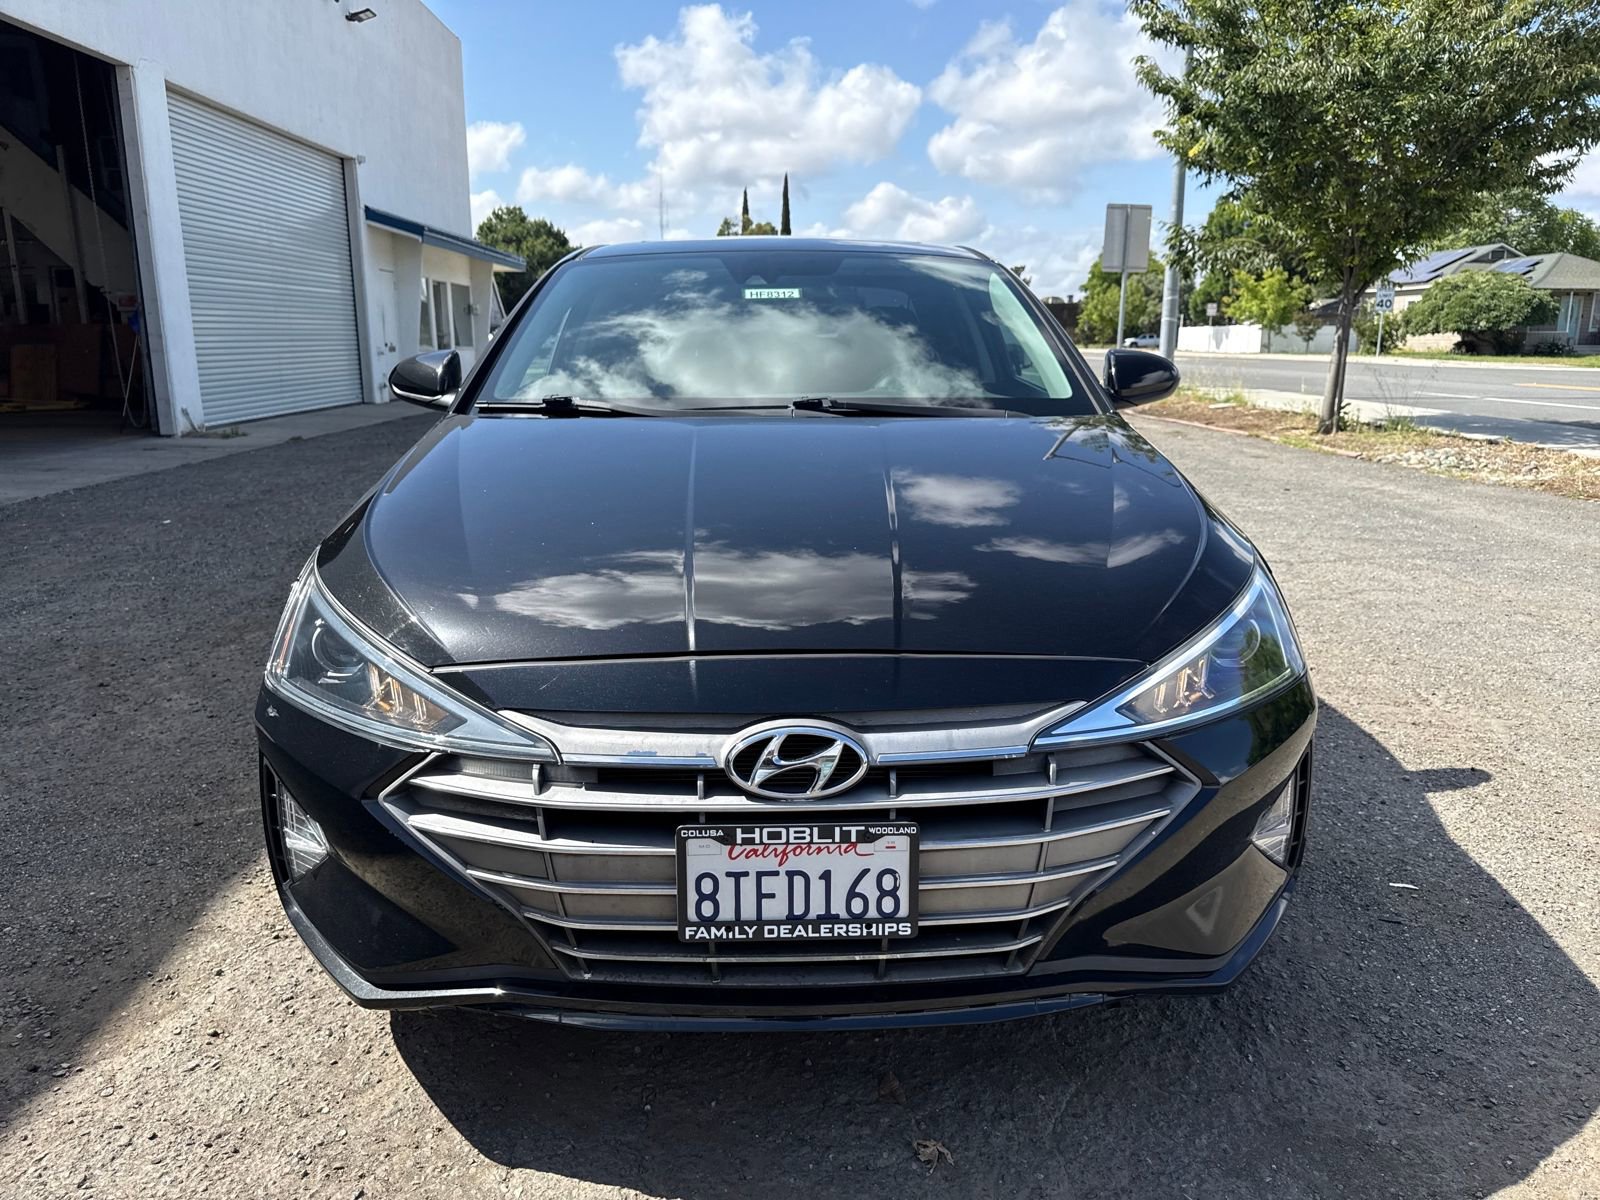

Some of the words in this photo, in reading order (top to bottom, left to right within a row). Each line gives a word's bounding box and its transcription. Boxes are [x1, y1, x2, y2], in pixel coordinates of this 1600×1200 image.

[1376, 299, 1393, 309] 40
[681, 829, 724, 837] COLUSA
[736, 826, 865, 844] HOBLIT
[727, 842, 874, 867] California
[694, 868, 901, 922] 8TFD168
[764, 922, 912, 938] DEALERSHIPS
